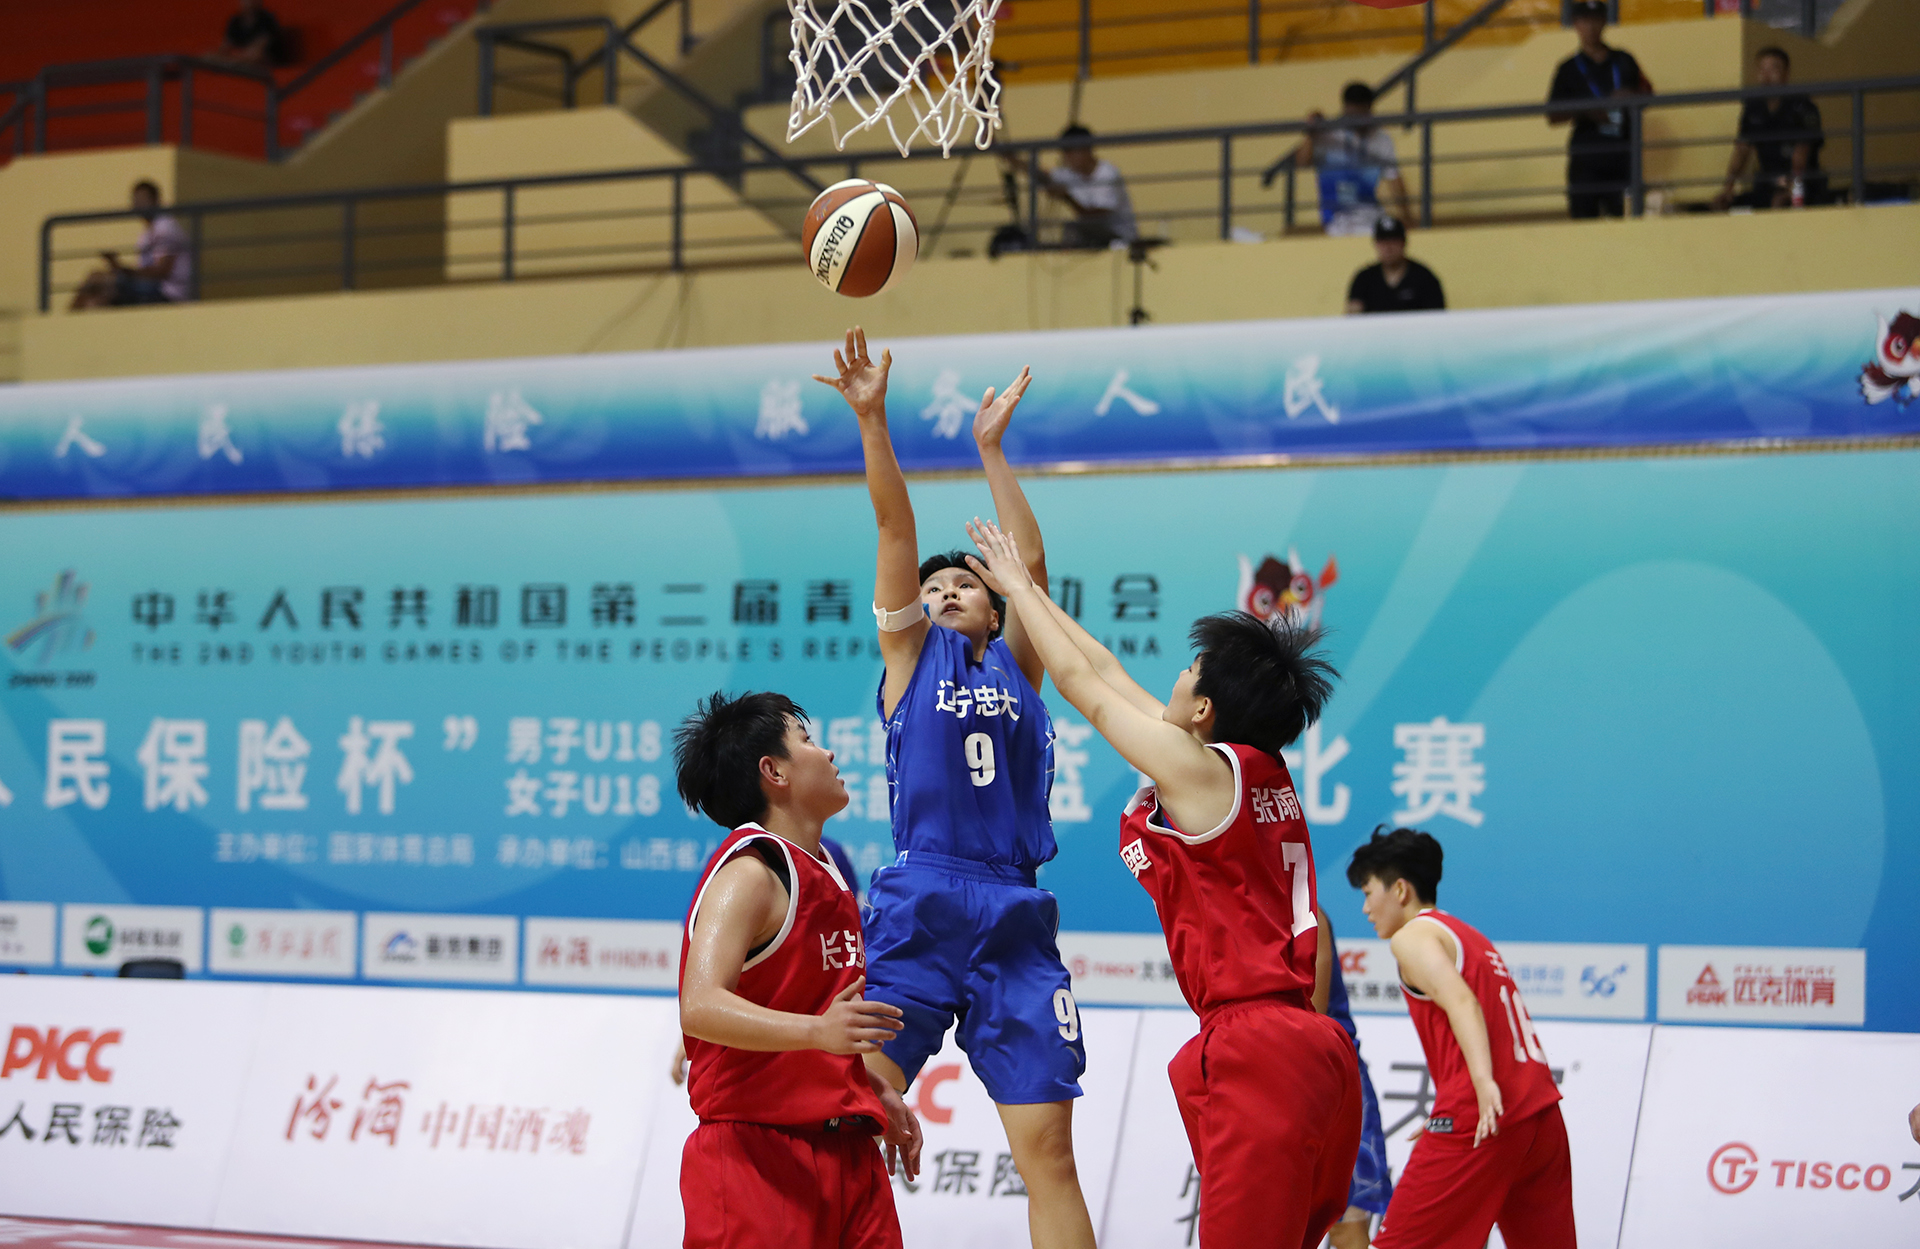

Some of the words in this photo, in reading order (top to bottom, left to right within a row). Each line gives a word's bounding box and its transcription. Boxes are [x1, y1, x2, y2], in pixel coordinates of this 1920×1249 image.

[936, 679, 1020, 721] 辽宁忠大
[964, 732, 996, 787] 9
[1280, 841, 1319, 938] 7
[1053, 988, 1078, 1041] 9
[1734, 976, 1836, 1007] 匹克体育
[0, 1024, 123, 1083] PICC
[0, 1100, 182, 1148] 人民保险
[1771, 1160, 1892, 1192] TISCO
